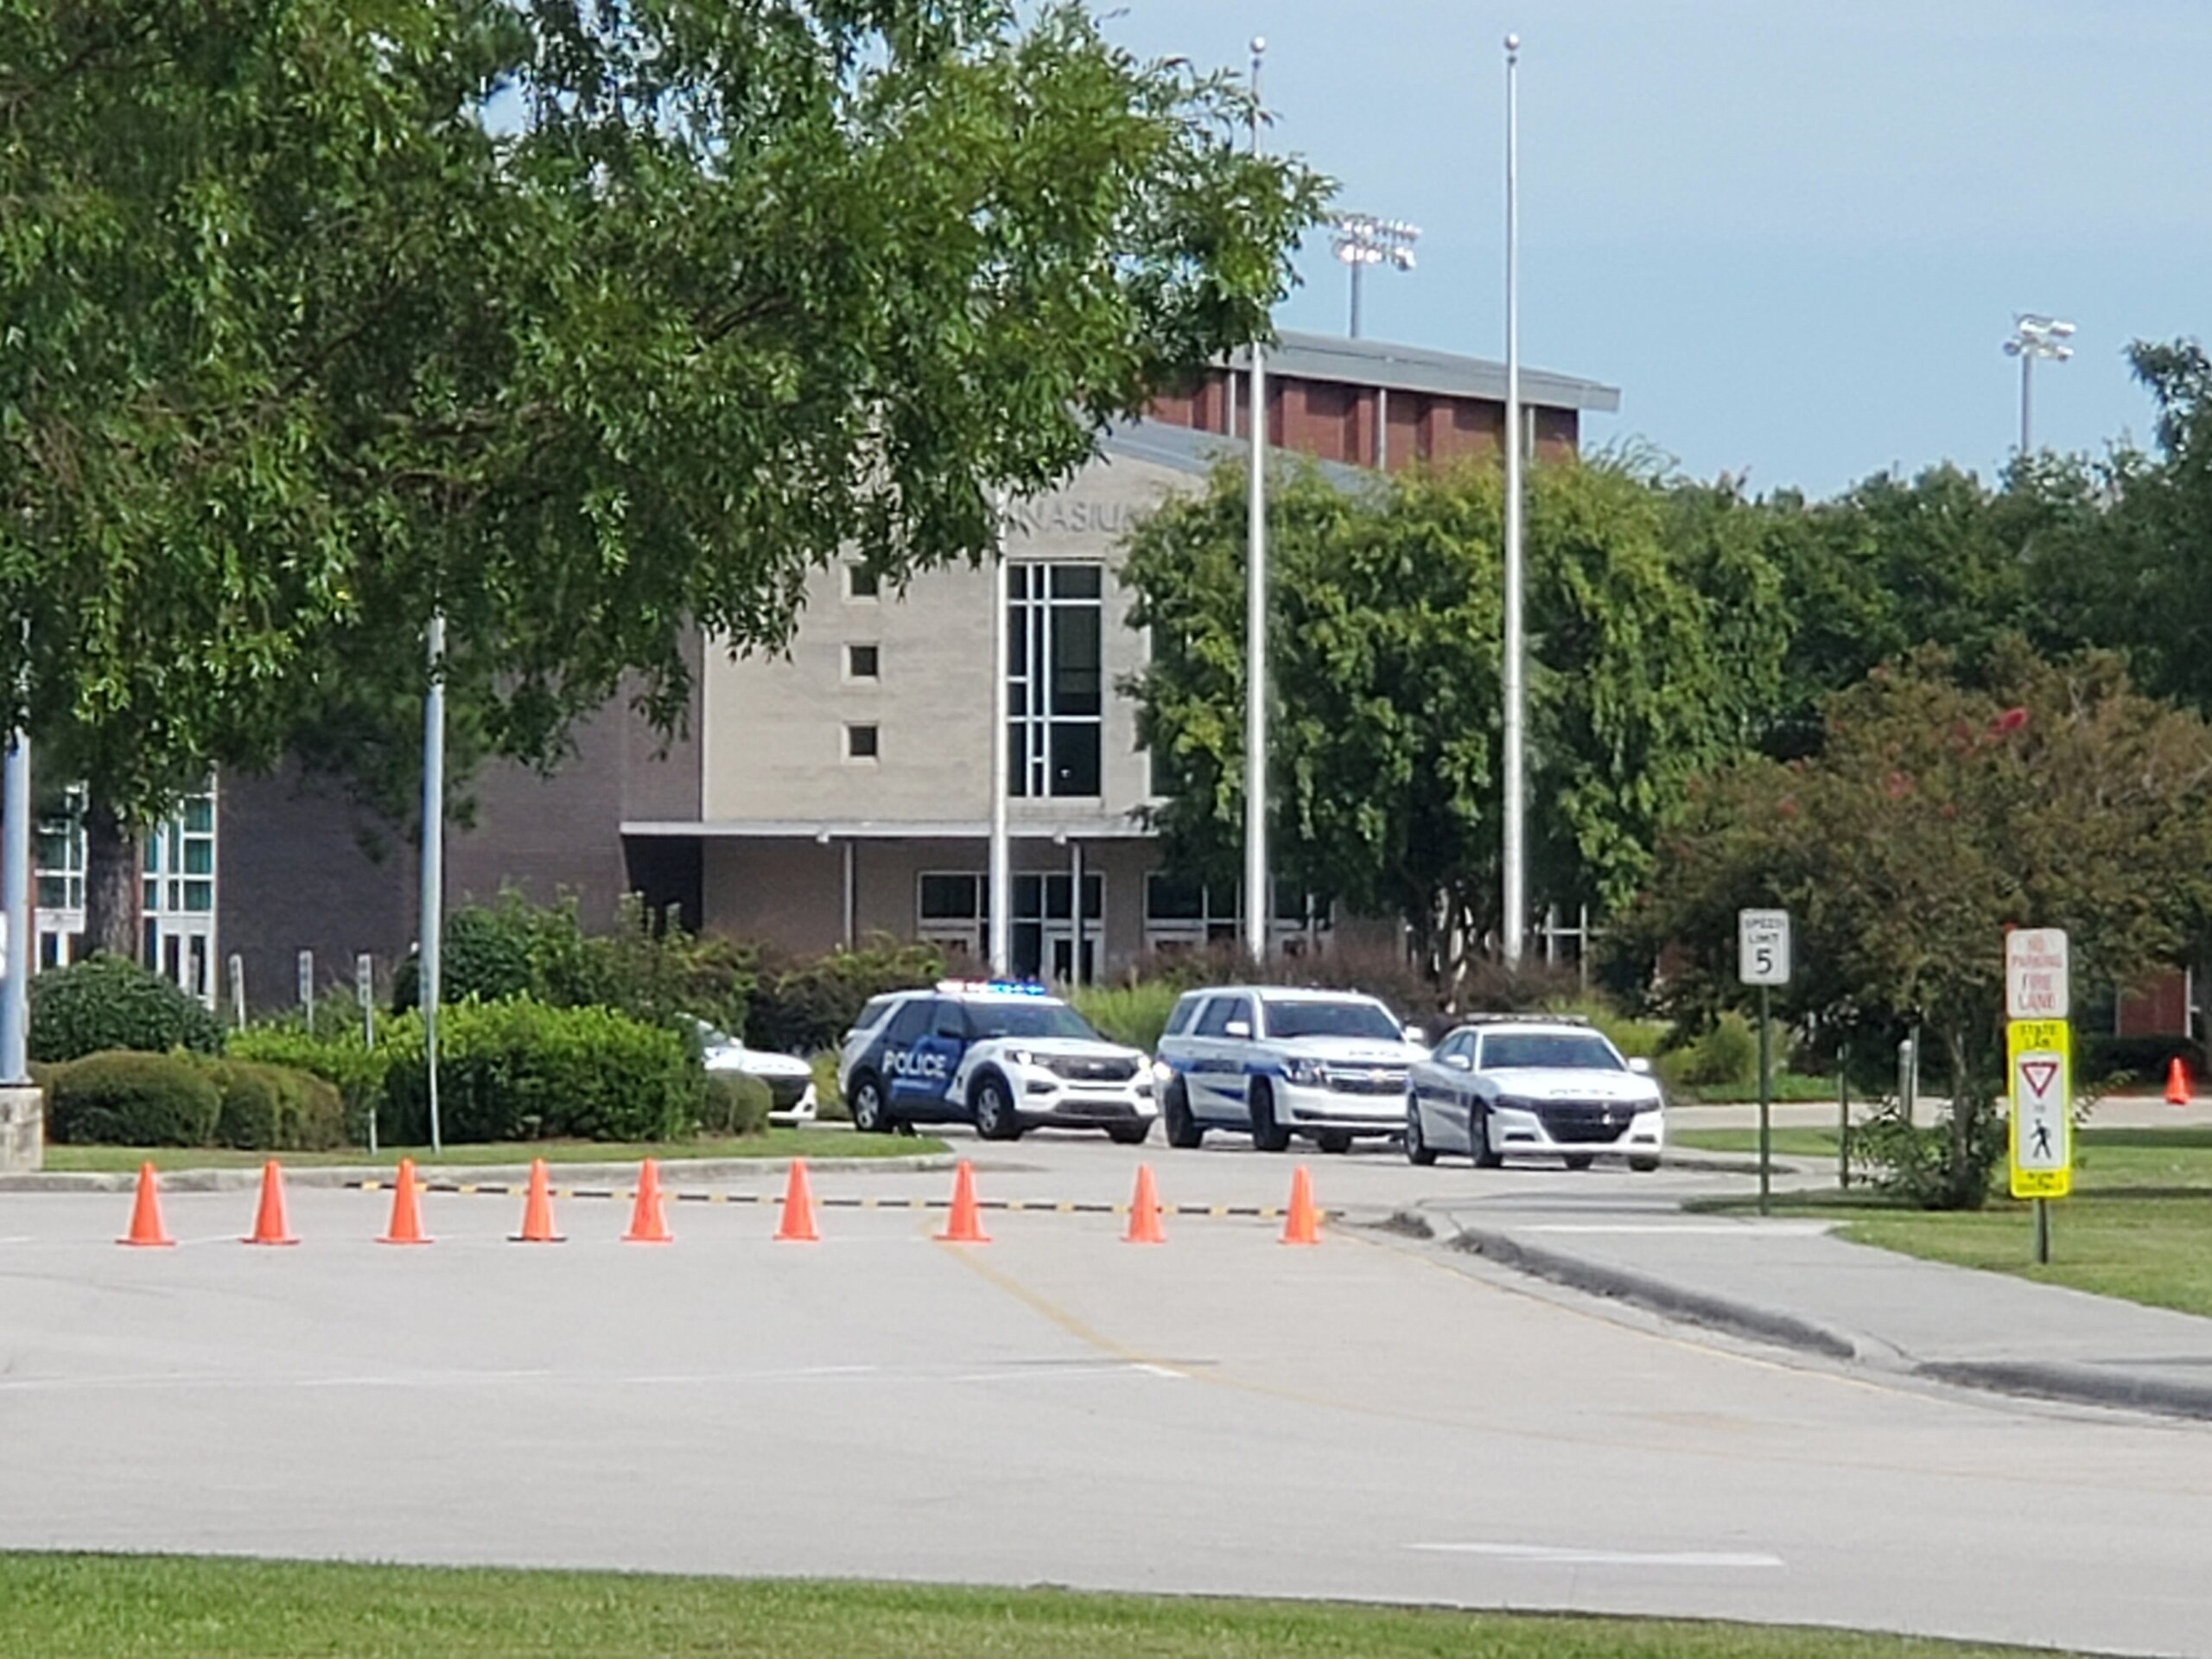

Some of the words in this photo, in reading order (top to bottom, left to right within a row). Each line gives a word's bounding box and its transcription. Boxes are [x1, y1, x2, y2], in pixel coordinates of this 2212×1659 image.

[1755, 948, 1772, 976] 5
[2022, 973, 2052, 991] FIRE
[2018, 993, 2056, 1011] LANE
[882, 1049, 947, 1078] POLICE
